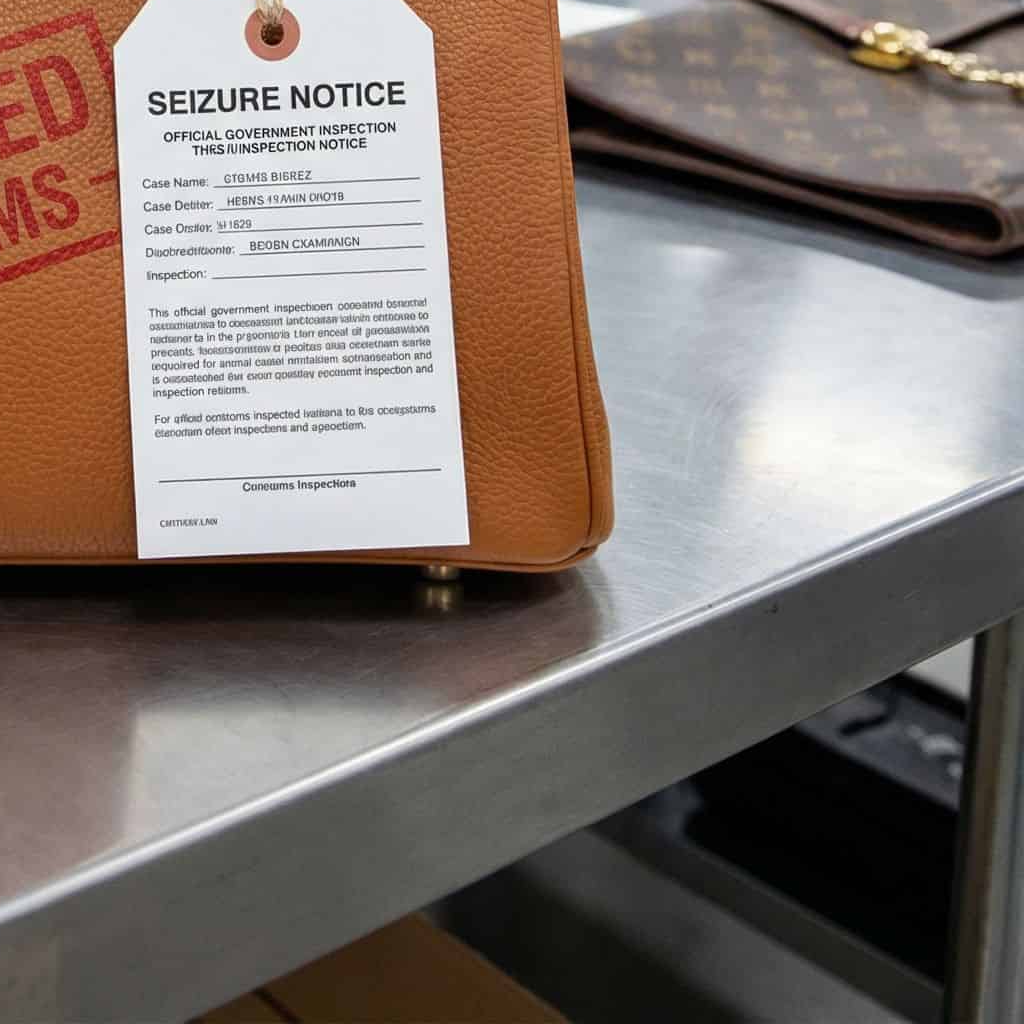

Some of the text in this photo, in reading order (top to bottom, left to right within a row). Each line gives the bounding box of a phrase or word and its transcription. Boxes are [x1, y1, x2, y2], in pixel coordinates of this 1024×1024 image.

[148, 81, 407, 116] SEIZURE NOTICE
[163, 122, 397, 143] OFFICIAL GOVERNMENT INSPECTION
[319, 137, 368, 150] NOTICE
[142, 178, 170, 189] Case
[173, 177, 208, 188] Name:
[143, 201, 172, 212] Case
[144, 224, 172, 235] Case
[211, 304, 270, 318] government
[218, 332, 233, 342] the
[203, 359, 216, 369] for
[414, 351, 432, 361] and
[416, 364, 433, 374] and
[153, 386, 204, 400] inspection
[154, 414, 170, 425] For
[253, 409, 300, 422] inspected
[345, 407, 355, 417] to
[290, 422, 309, 433] and
